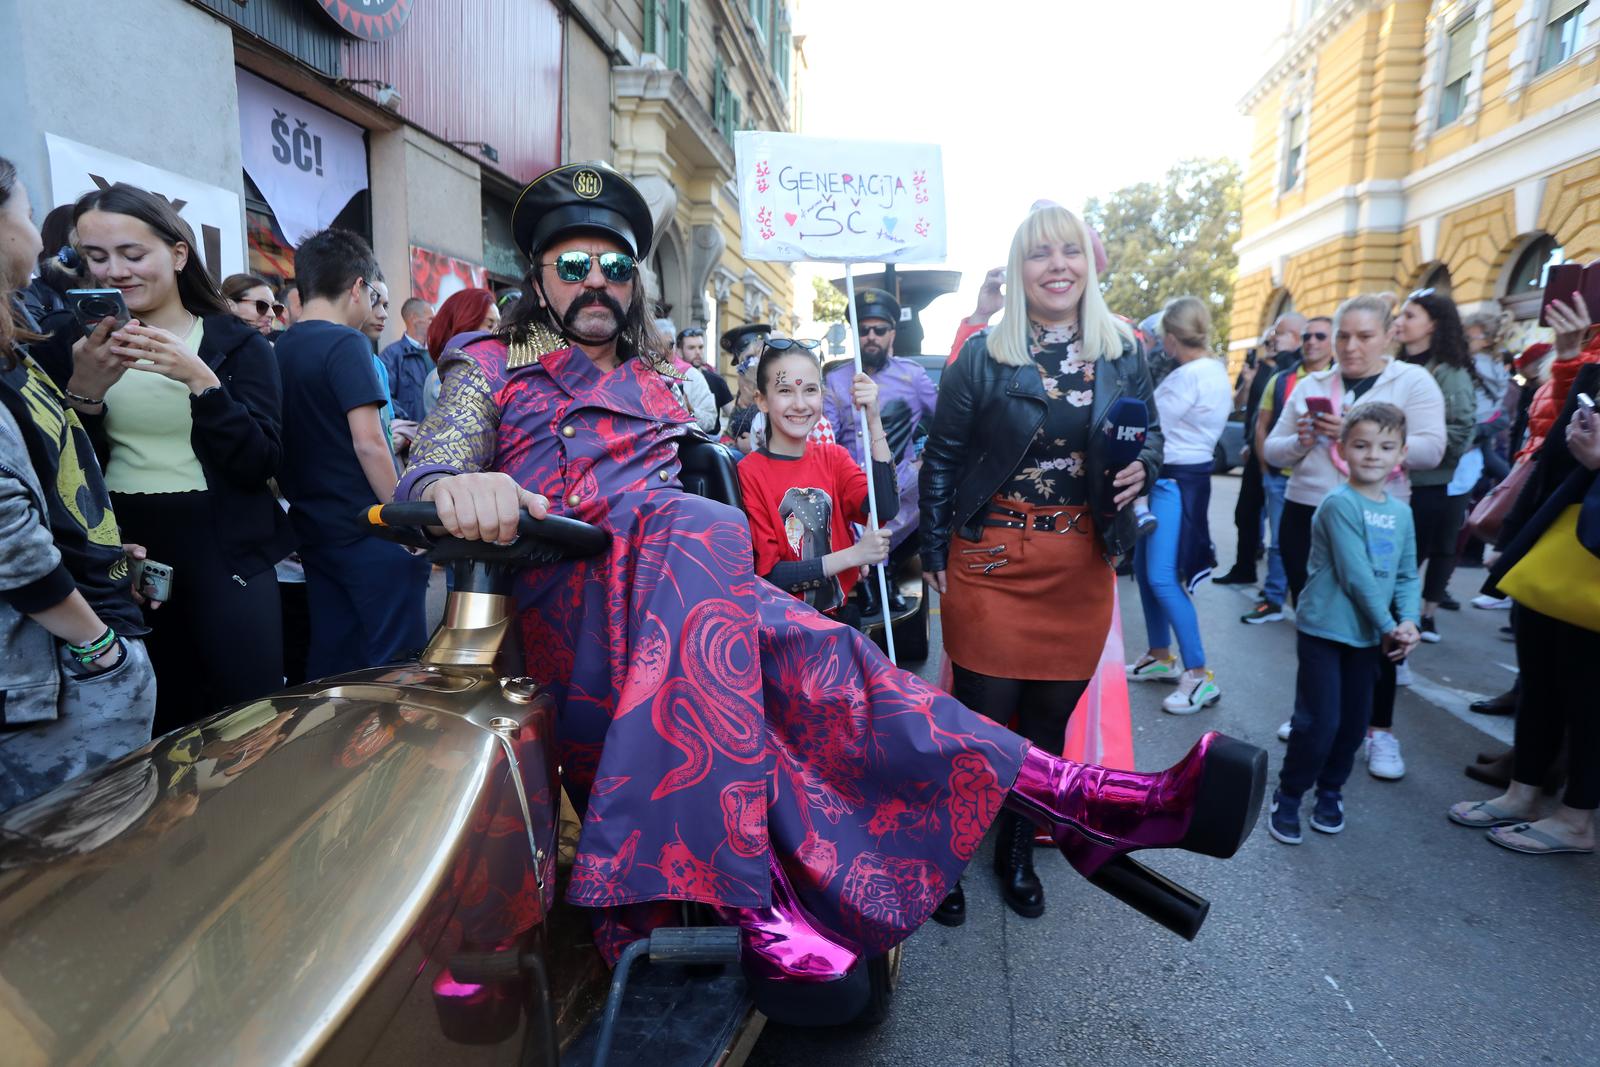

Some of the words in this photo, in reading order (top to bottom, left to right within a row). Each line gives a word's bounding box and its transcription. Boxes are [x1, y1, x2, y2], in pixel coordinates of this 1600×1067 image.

[271, 108, 323, 177] ŠČ!
[578, 172, 598, 194] ŠČ!
[800, 194, 866, 239] ŠČ
